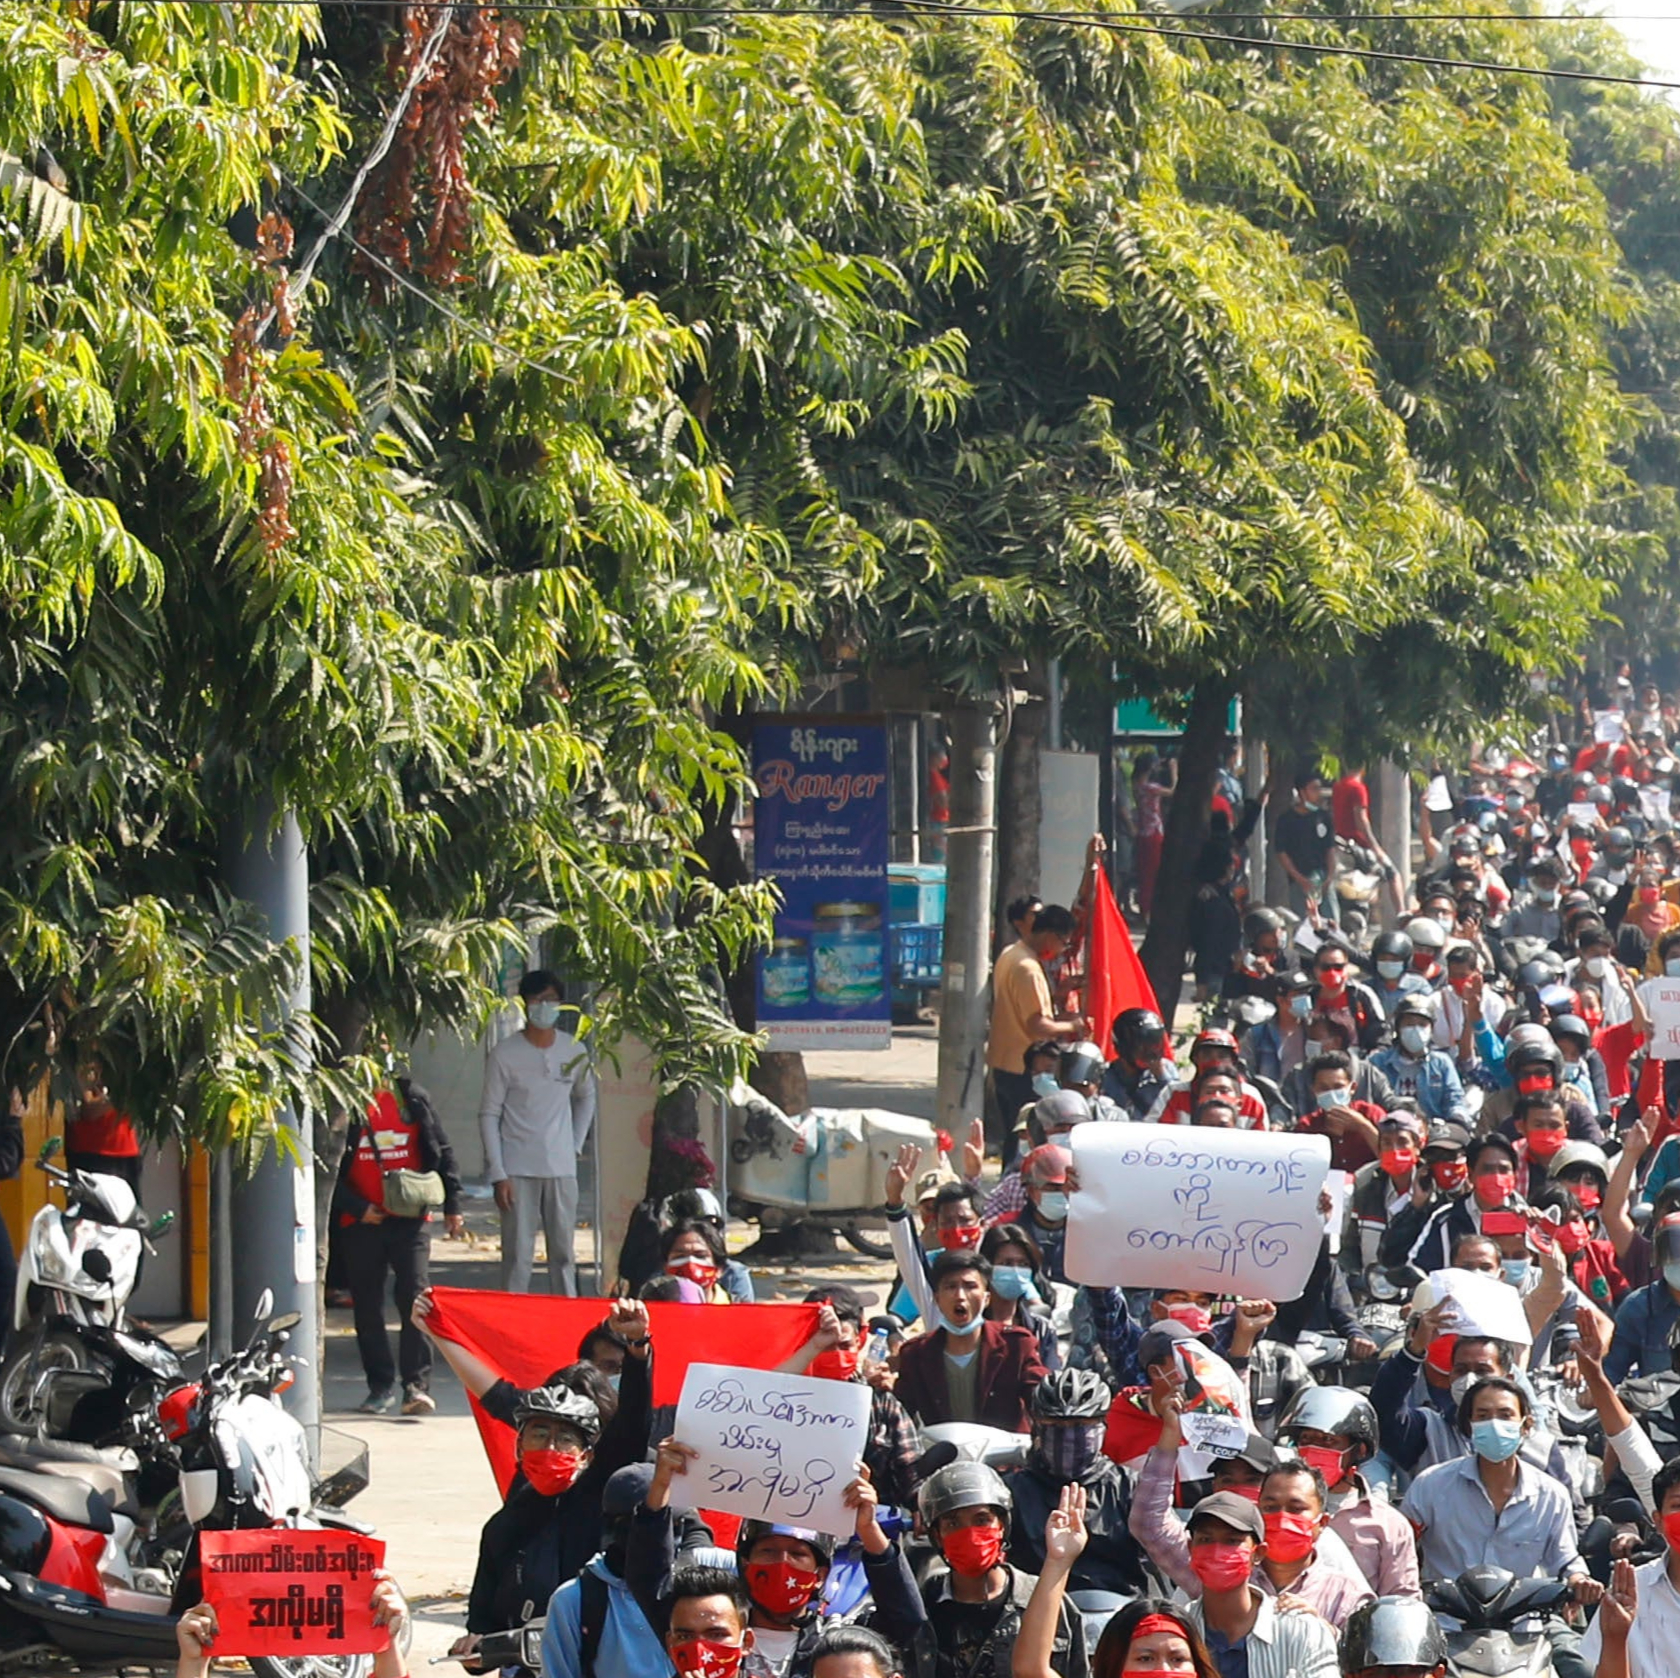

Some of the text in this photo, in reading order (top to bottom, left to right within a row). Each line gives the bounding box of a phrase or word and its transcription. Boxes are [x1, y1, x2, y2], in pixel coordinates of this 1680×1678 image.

[756, 759, 885, 812] Ranger
[1173, 1173, 1225, 1222] ကို
[248, 1584, 346, 1640] အလိုမရှိ
